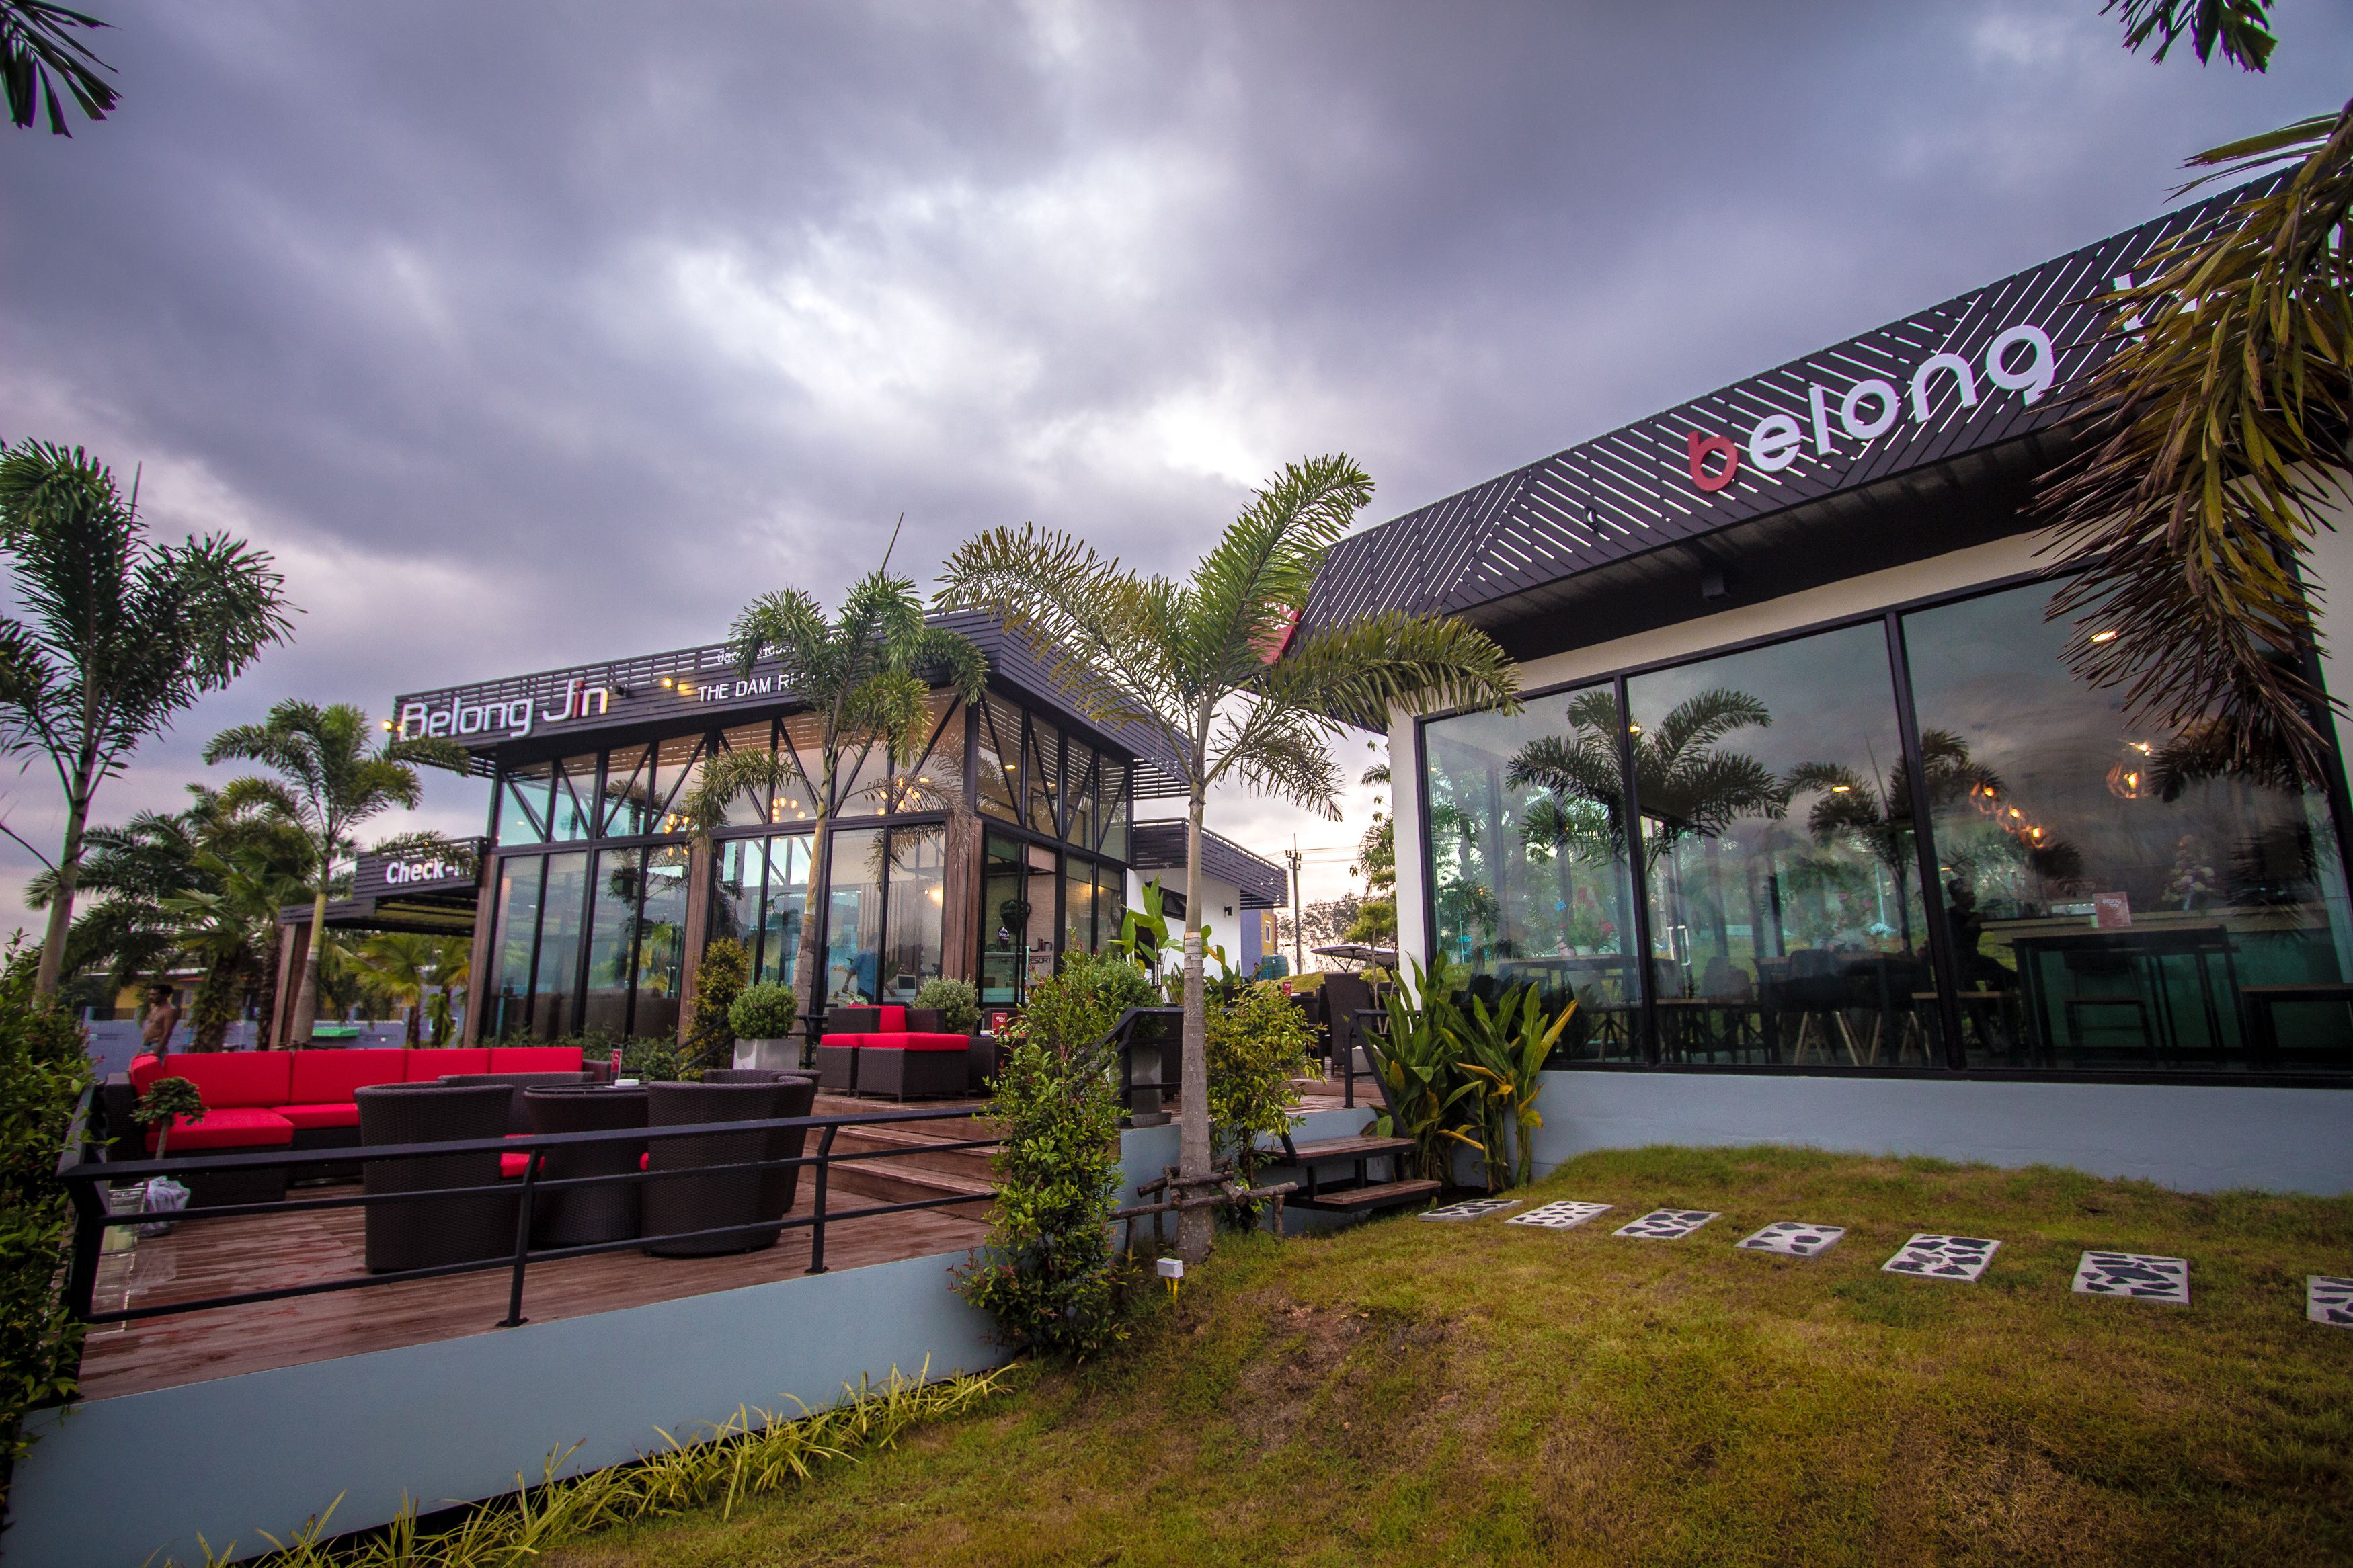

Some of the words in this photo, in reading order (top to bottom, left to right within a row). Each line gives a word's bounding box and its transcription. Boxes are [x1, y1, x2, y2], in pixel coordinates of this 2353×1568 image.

[1687, 324, 2055, 493] belong
[401, 697, 534, 741] Belong
[542, 678, 608, 723] Jin
[698, 683, 729, 702] THE
[735, 677, 771, 697] DAM
[1029, 938, 1053, 952] Jin
